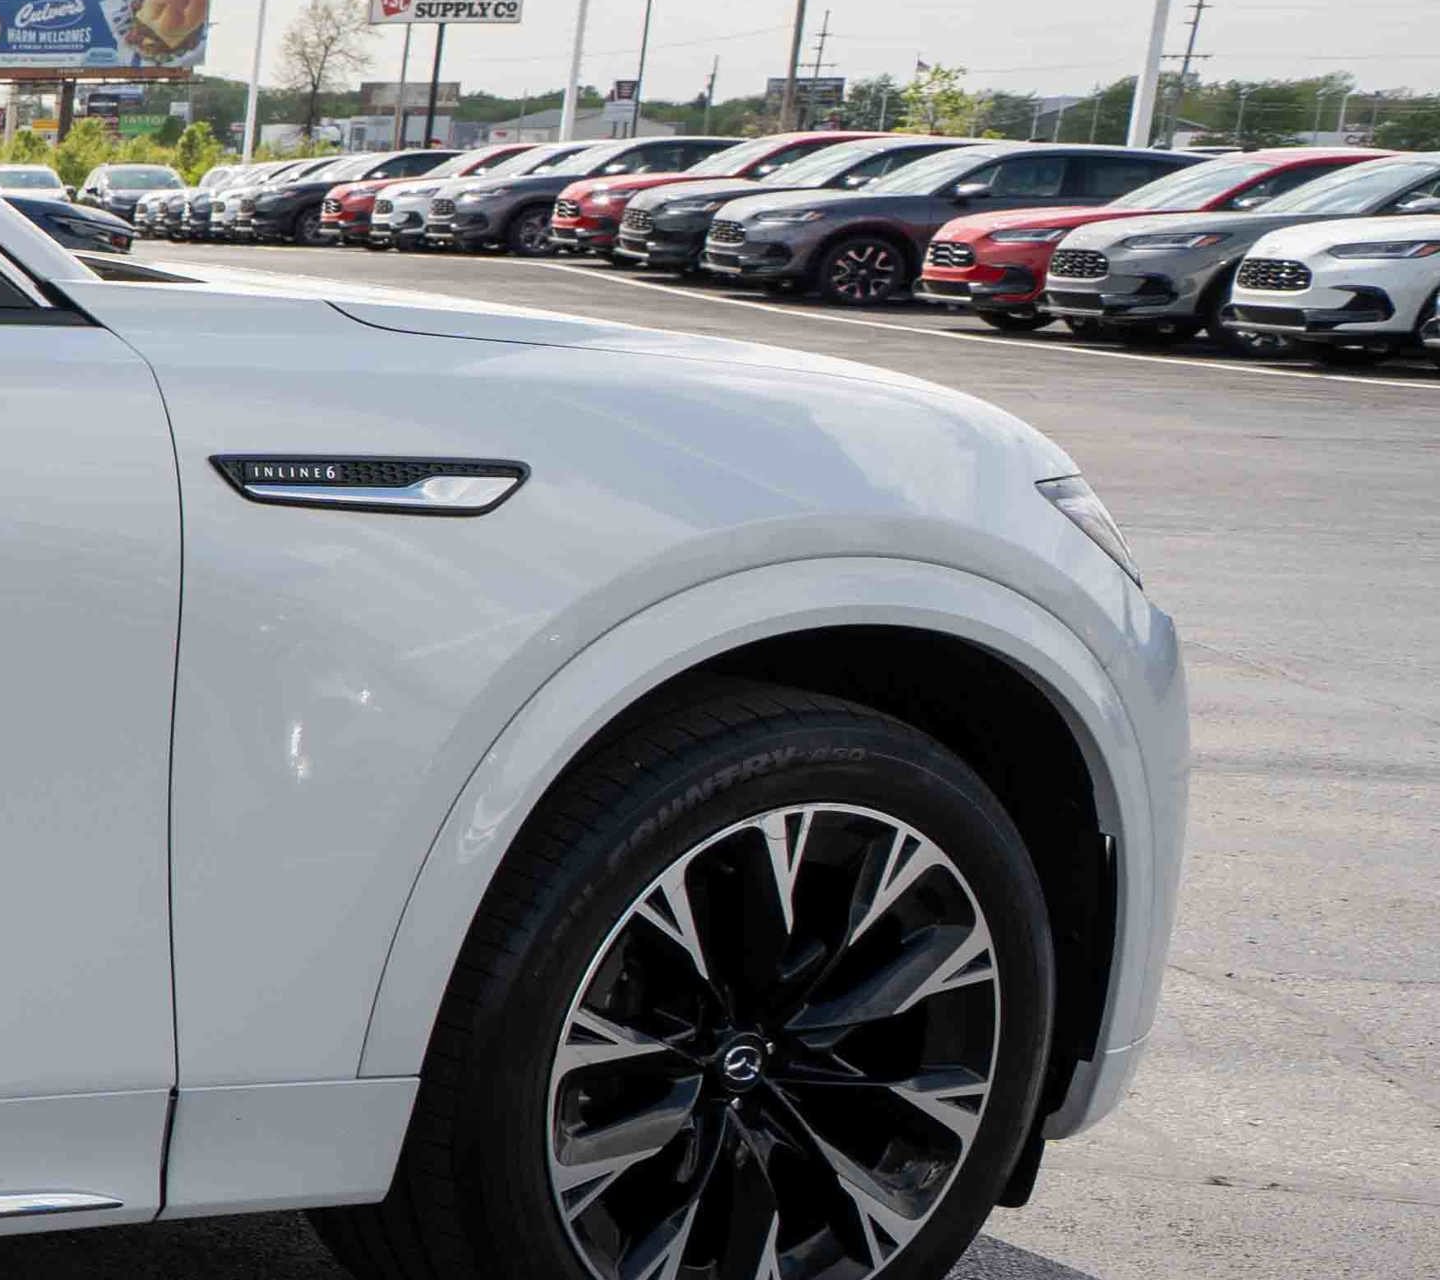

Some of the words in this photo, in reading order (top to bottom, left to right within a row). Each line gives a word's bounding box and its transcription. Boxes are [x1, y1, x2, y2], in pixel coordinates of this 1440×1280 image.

[415, 1, 491, 18] SUPPLY
[7, 27, 36, 43] WARM
[39, 26, 92, 43] WELCOMES
